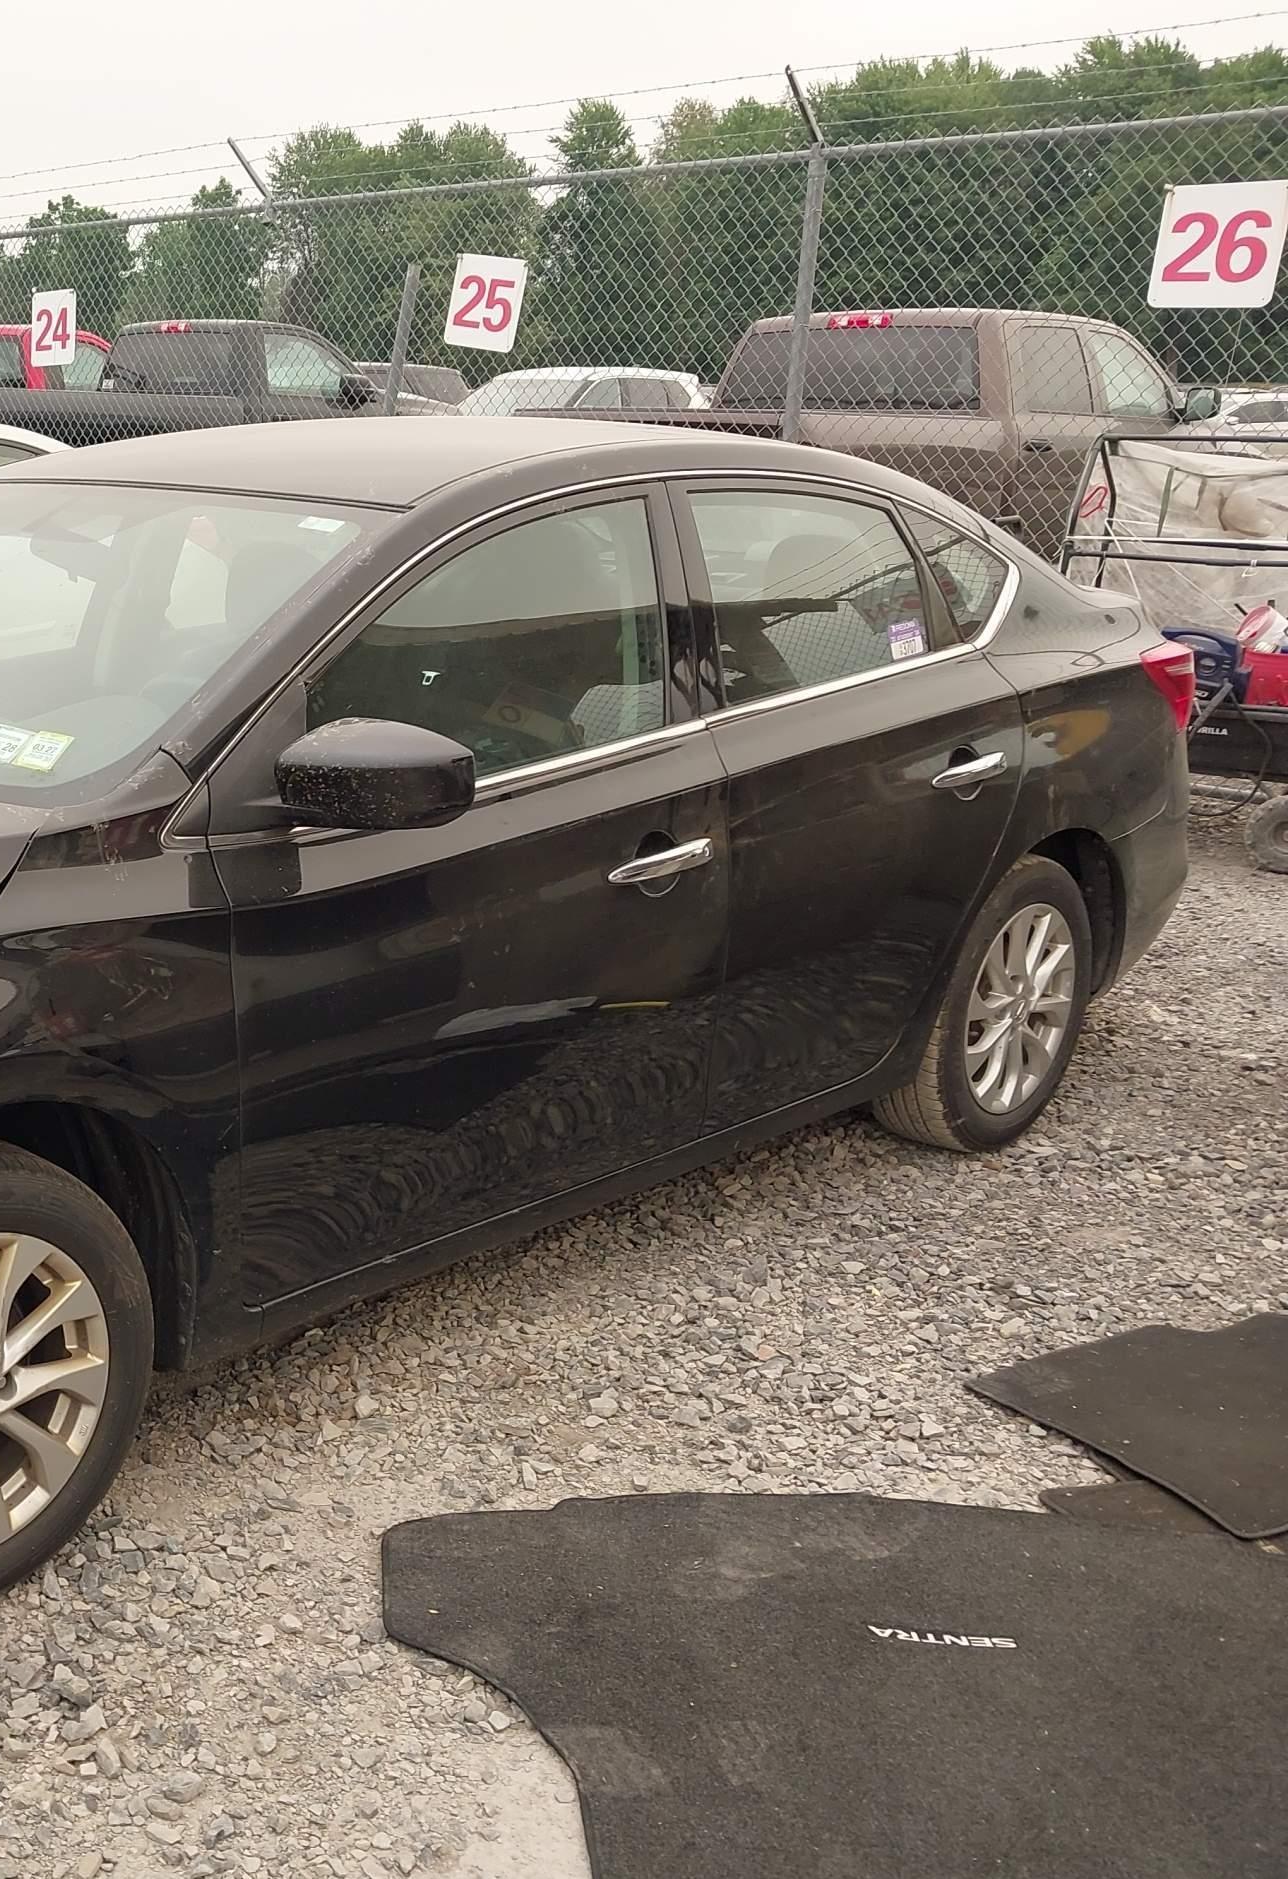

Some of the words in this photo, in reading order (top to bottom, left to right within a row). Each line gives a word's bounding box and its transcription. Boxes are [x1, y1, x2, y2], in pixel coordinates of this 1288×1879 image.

[1161, 209, 1273, 283] 26
[452, 275, 516, 332] 25
[35, 307, 70, 351] 24
[1, 742, 18, 753] 28
[867, 1625, 1017, 1649] SENTRA
